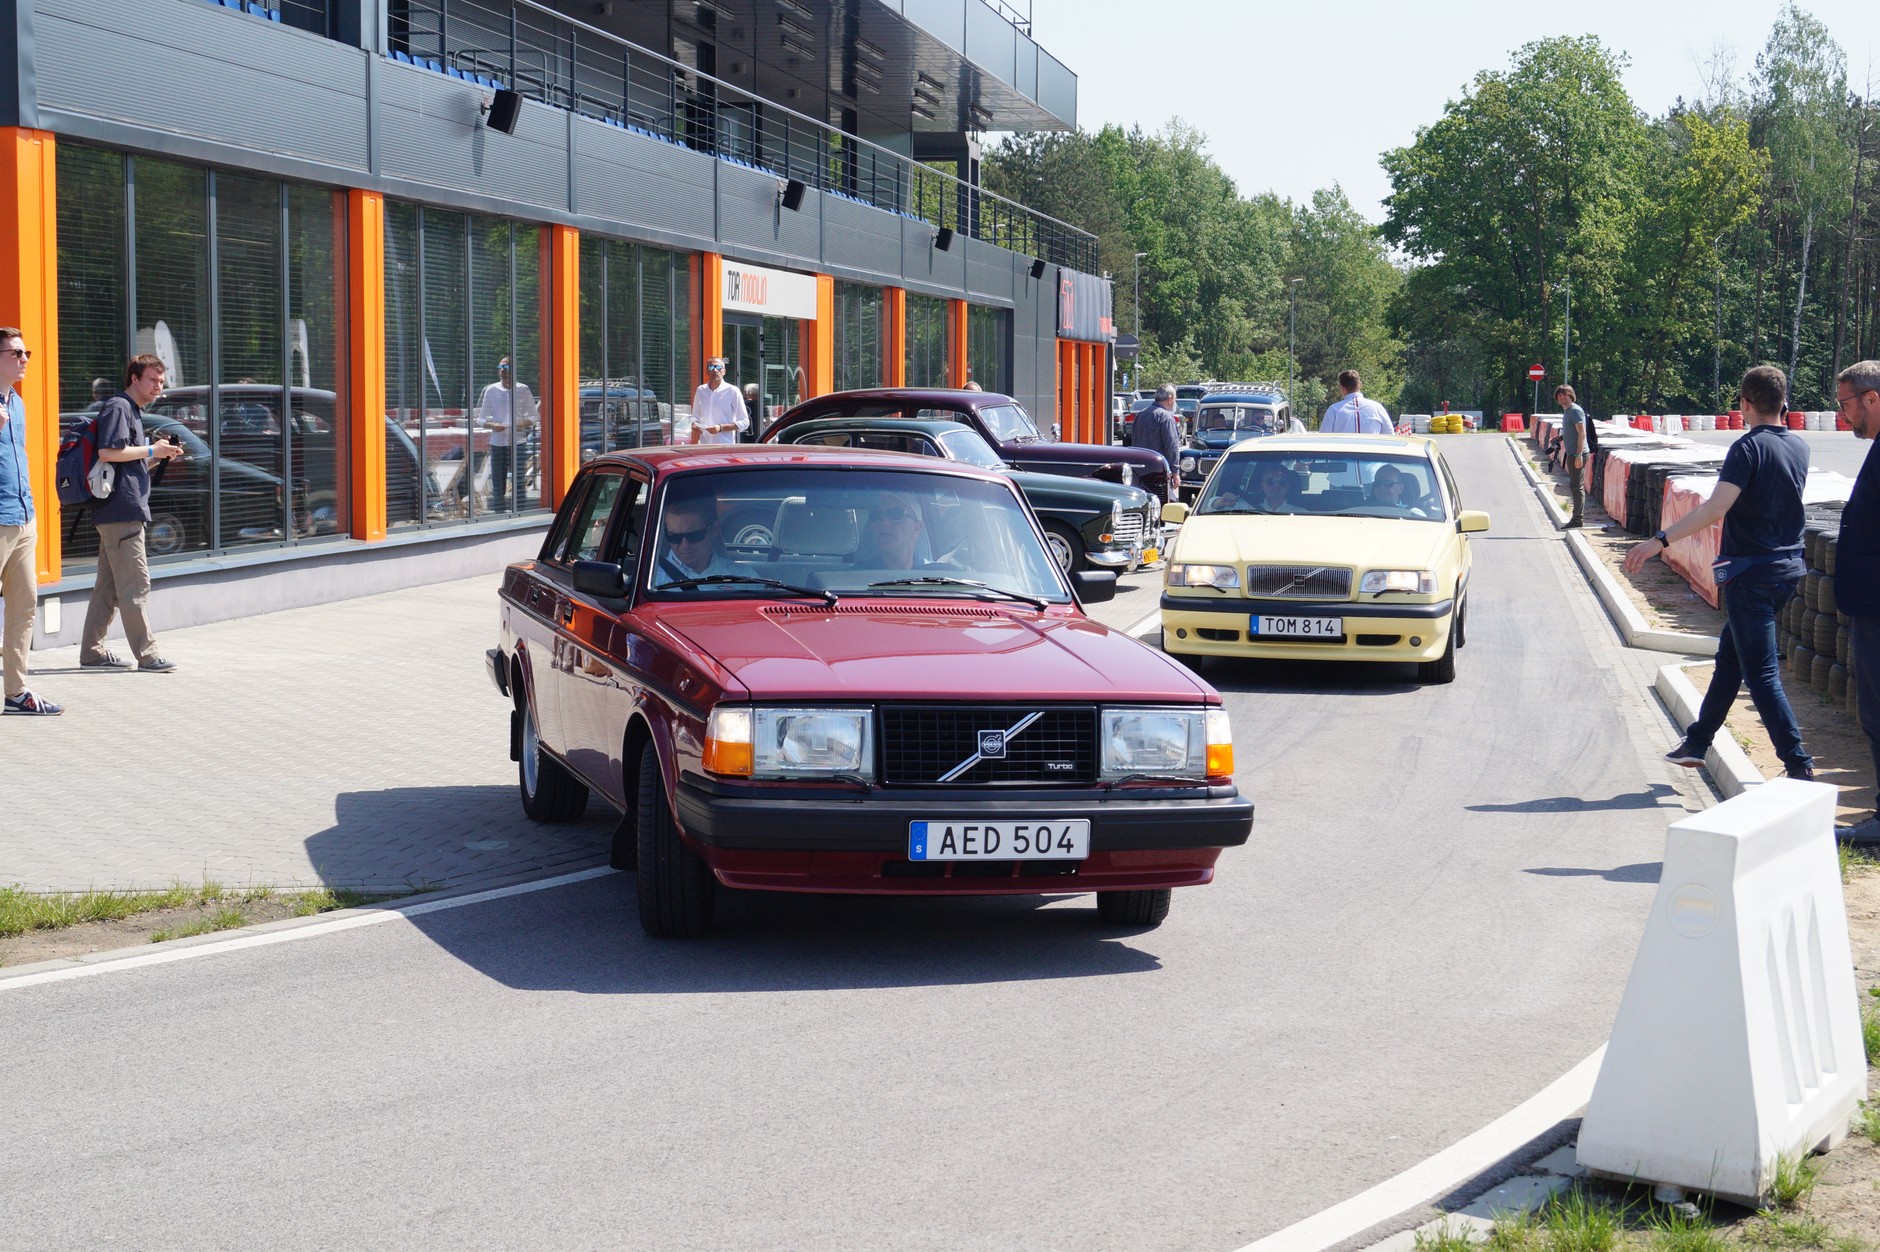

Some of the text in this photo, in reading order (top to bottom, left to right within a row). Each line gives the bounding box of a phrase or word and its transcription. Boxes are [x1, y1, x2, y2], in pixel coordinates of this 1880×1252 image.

[728, 270, 740, 302] TOR
[1265, 617, 1334, 634] TOM 814
[915, 845, 922, 853] S
[939, 825, 1074, 855] AED 504
